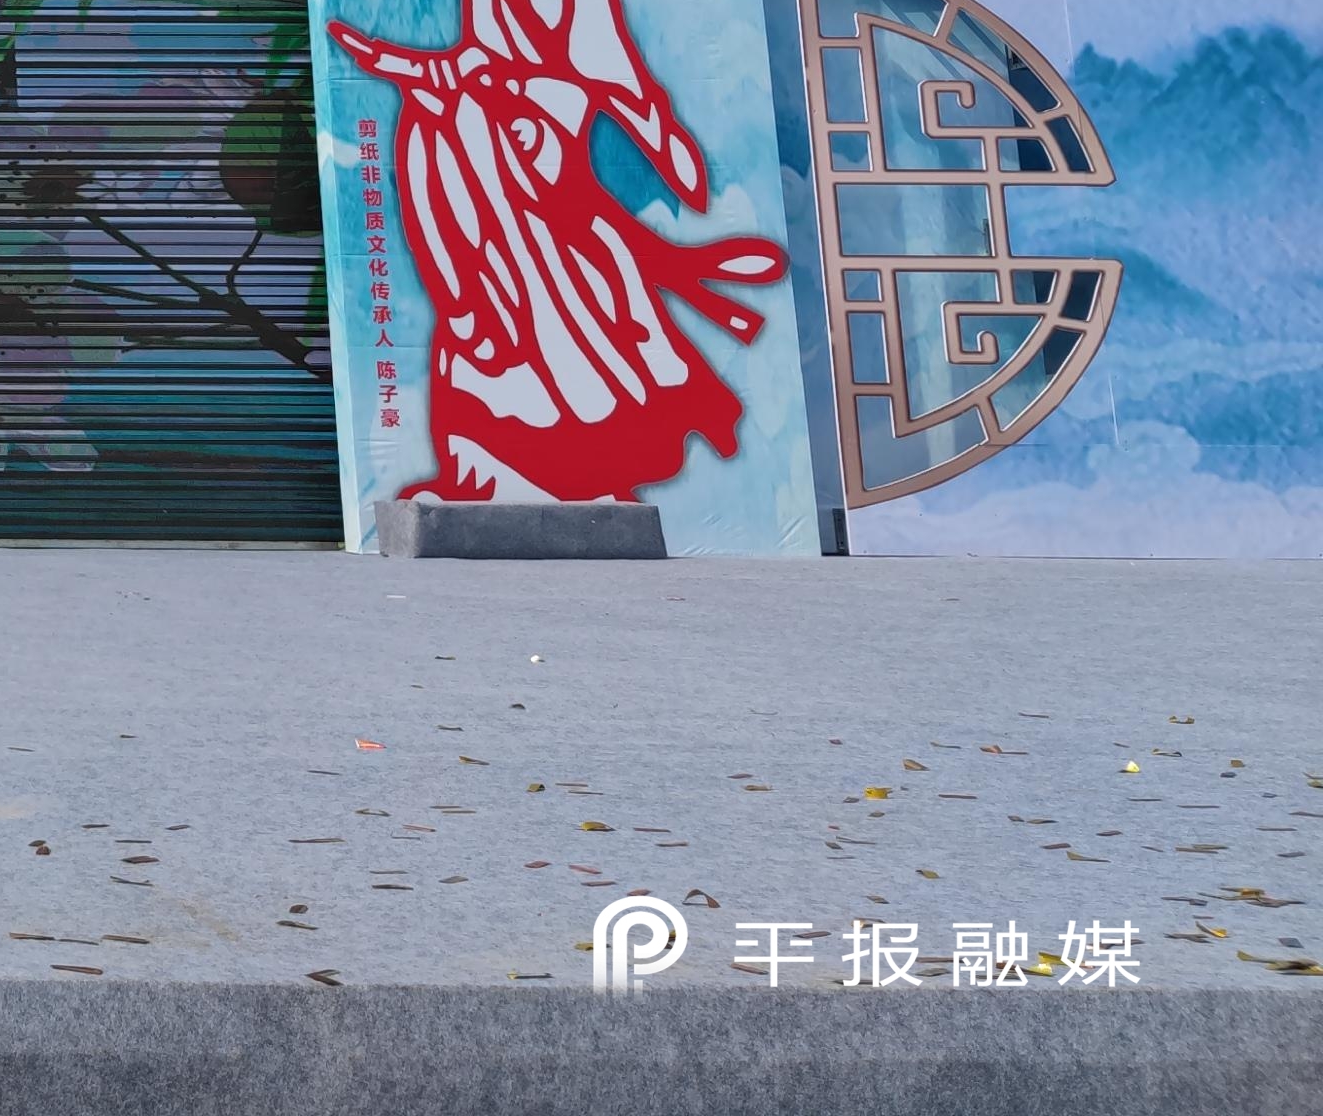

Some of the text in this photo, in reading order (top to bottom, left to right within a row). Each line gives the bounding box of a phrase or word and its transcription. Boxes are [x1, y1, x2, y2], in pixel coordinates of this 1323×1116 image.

[357, 118, 402, 429] 剪纸非物质文化传承人 陈子豪
